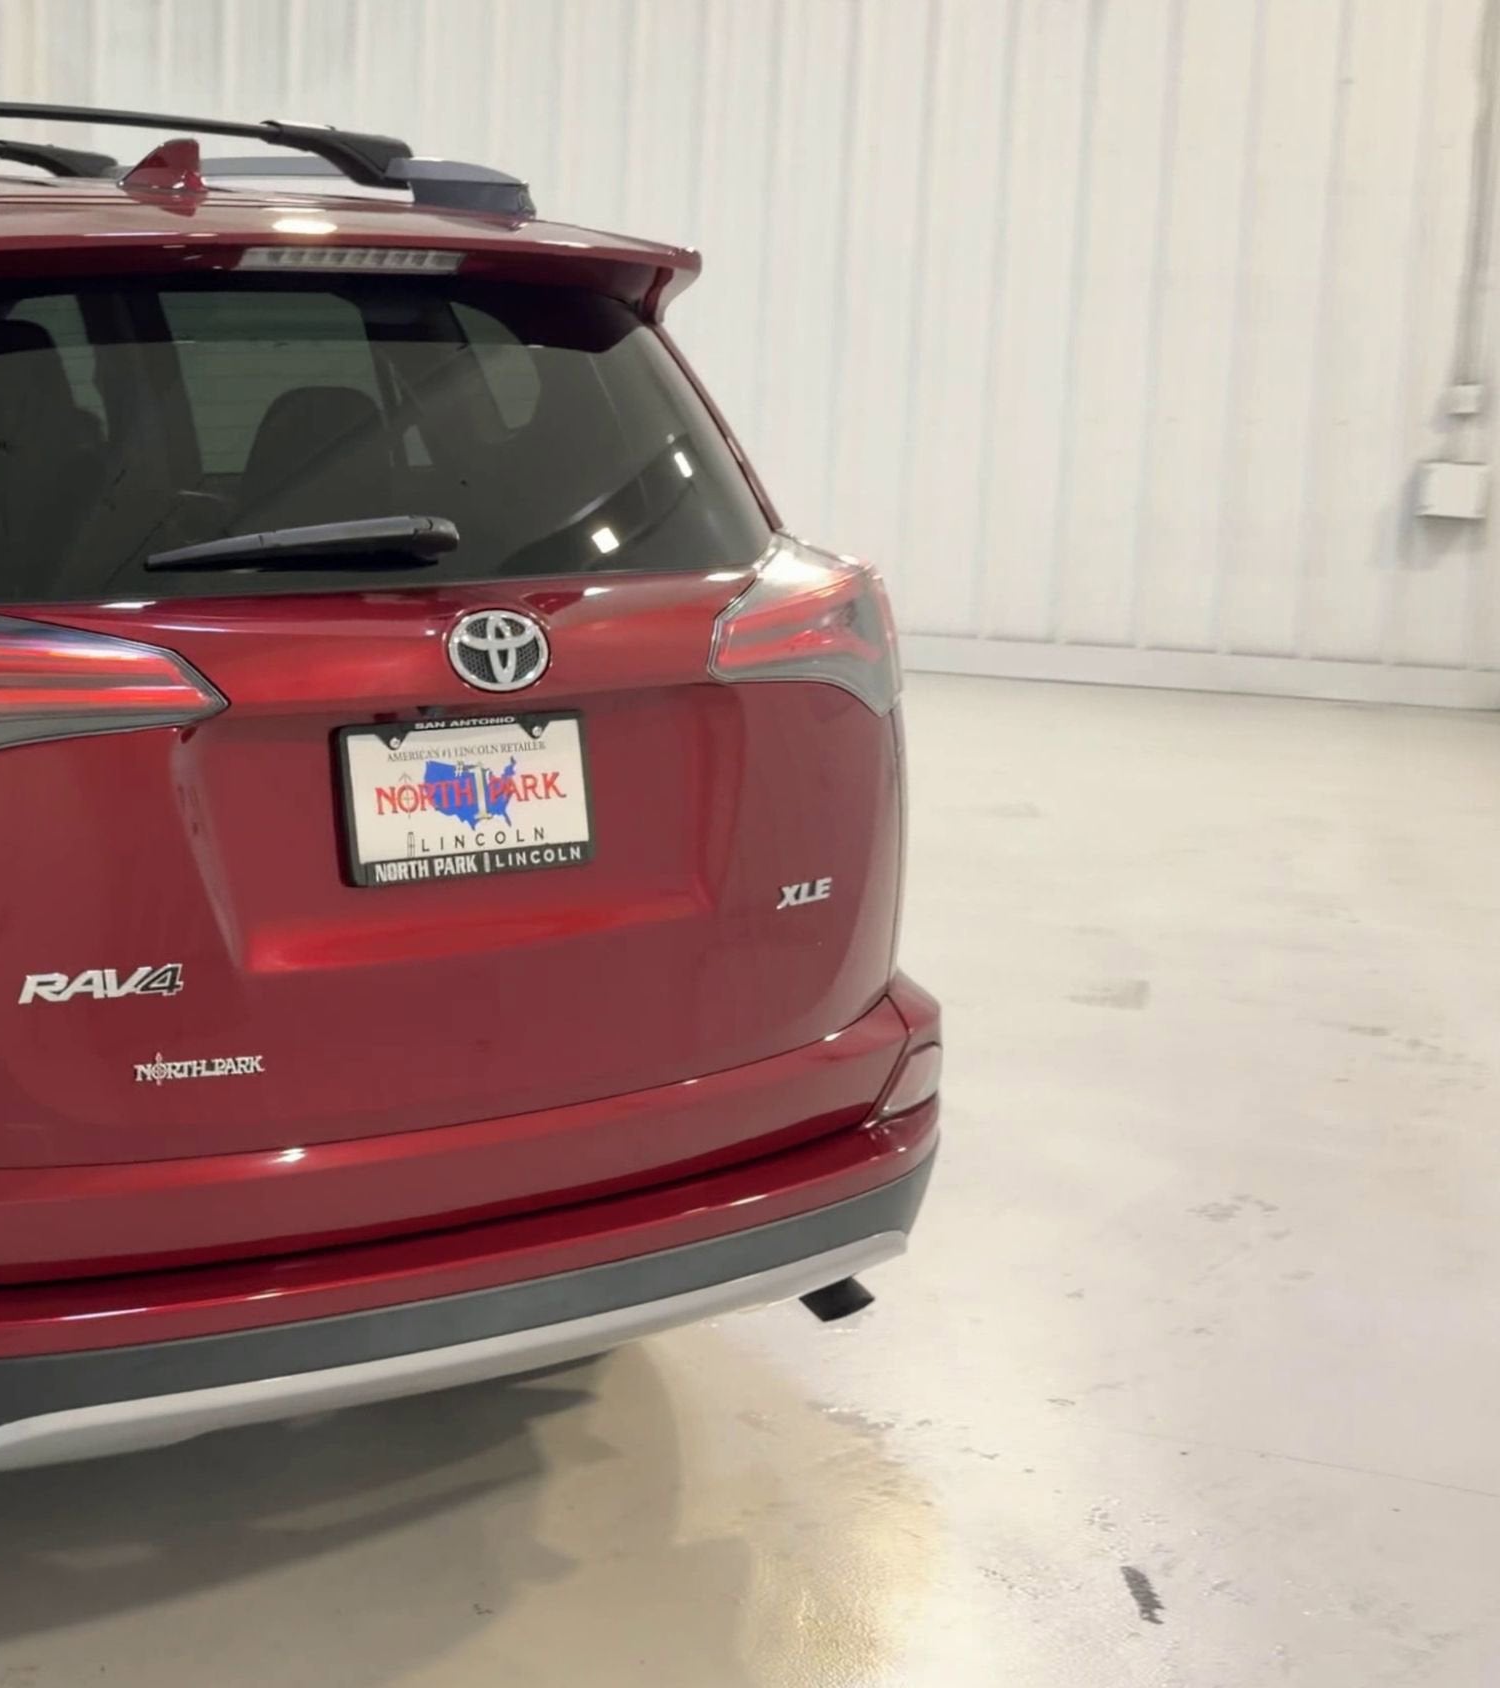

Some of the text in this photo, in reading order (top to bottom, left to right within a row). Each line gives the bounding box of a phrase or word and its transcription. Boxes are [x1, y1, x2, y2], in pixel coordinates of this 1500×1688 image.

[414, 716, 516, 730] SAN ANTONIO
[453, 743, 499, 758] LINCOLN
[499, 740, 547, 753] RETAILER
[374, 771, 567, 816] NORTH PARK
[421, 826, 546, 853] LINCOLN
[374, 846, 582, 883] NORTH PARK LINCOLN
[776, 877, 832, 910] XLE
[18, 963, 184, 1005] RAV4
